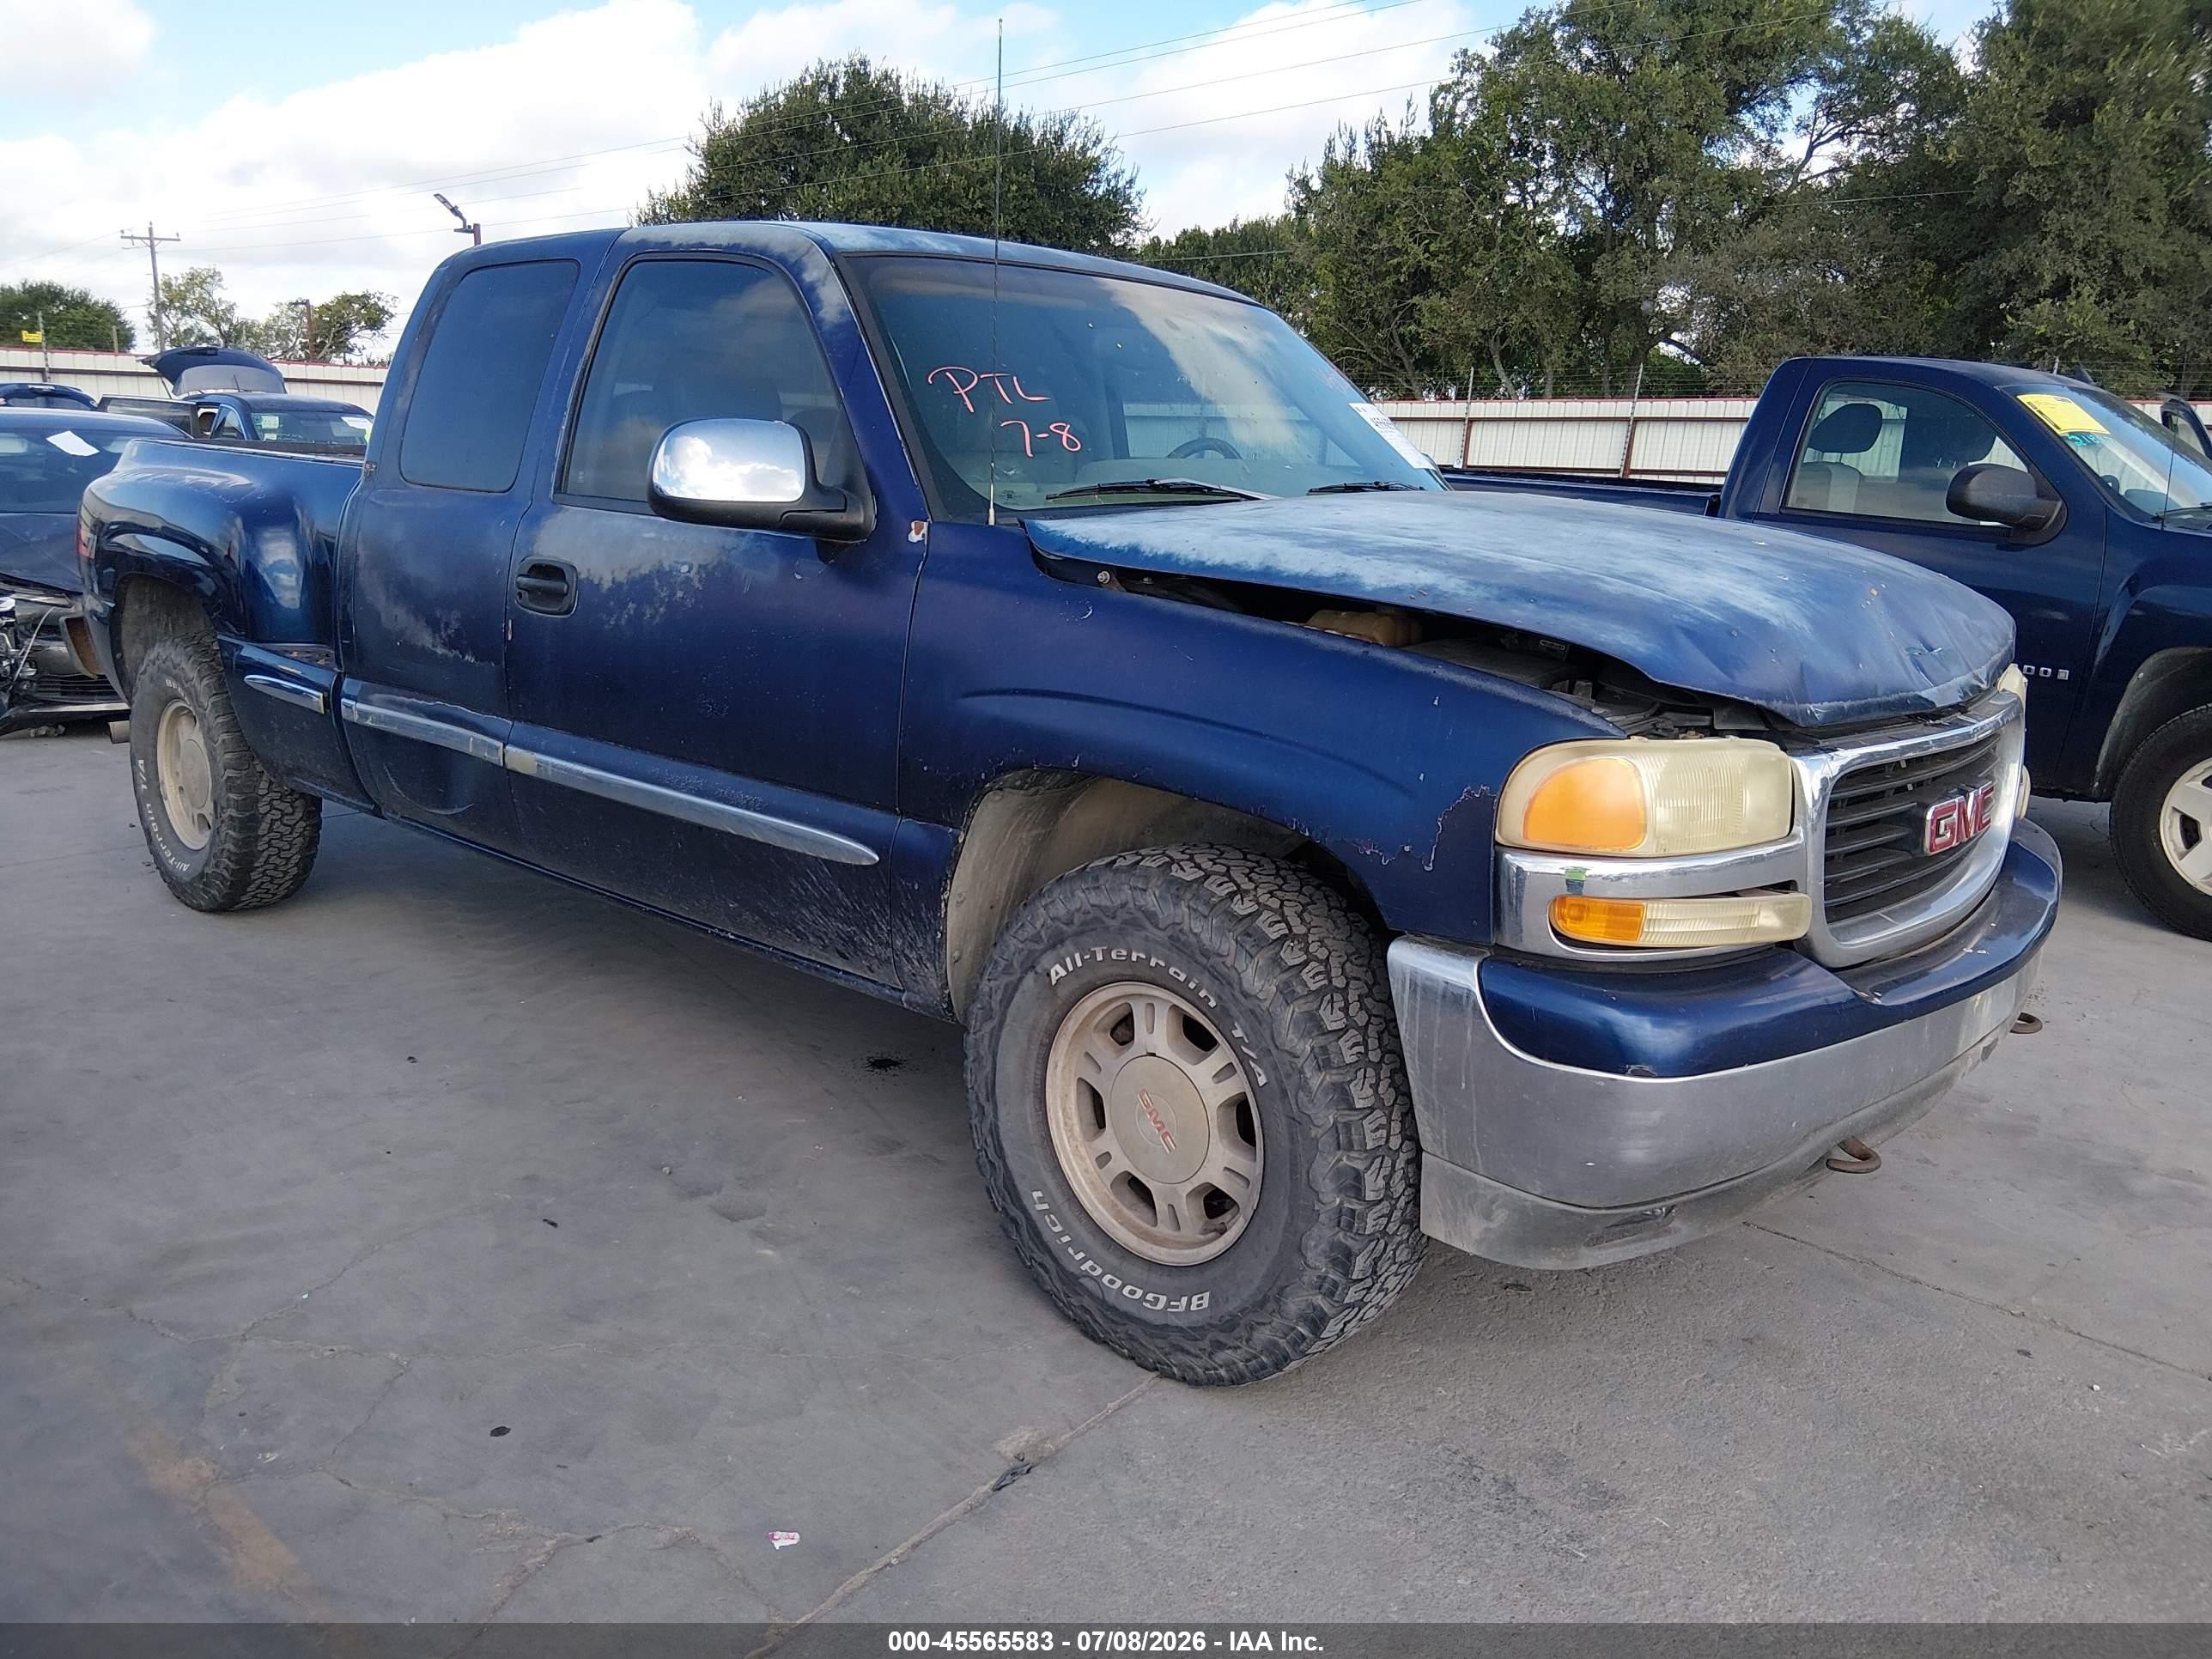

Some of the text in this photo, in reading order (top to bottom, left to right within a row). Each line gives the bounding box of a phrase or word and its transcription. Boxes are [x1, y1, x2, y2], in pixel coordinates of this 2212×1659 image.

[927, 366, 1052, 413] PTL
[1000, 420, 1082, 458] 7-8
[1924, 781, 1994, 856] GMC
[1048, 945, 1268, 1087] All-Terrain T/A
[1137, 1087, 1177, 1154] GMC
[1031, 1190, 1211, 1313] BFGoodrich
